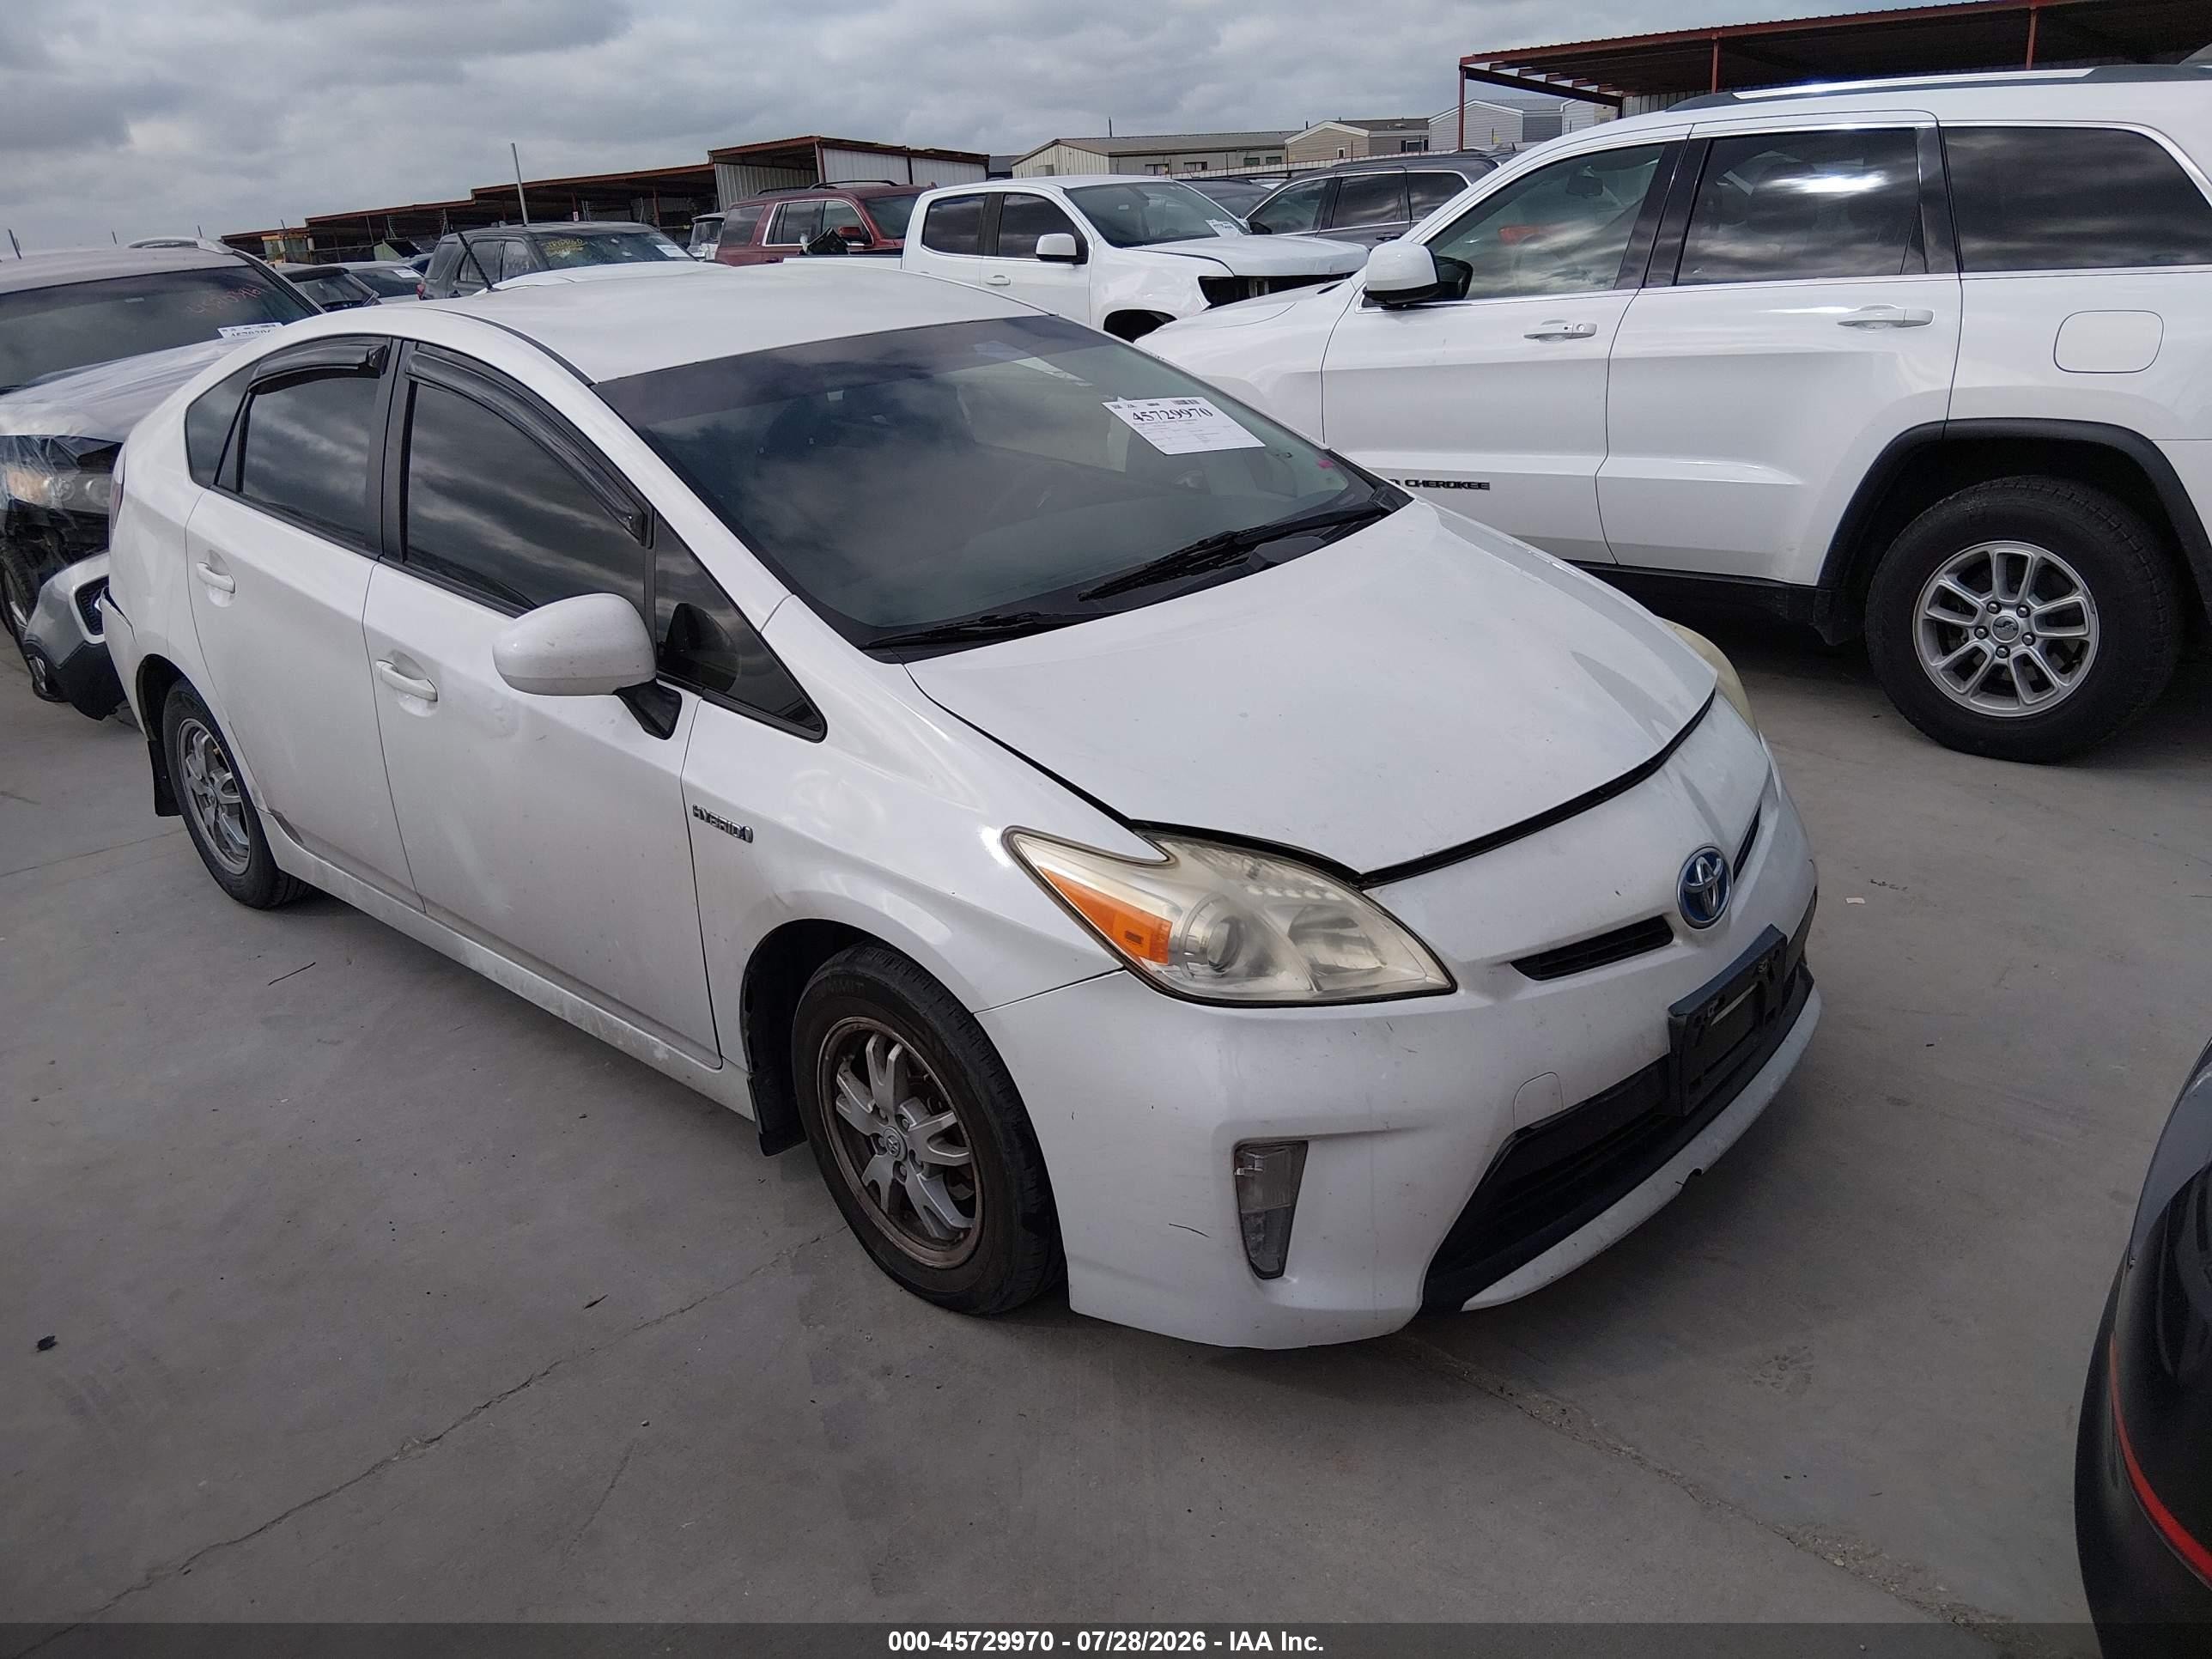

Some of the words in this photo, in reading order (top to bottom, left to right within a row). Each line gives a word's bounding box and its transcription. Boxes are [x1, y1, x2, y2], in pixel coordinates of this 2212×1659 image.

[1132, 407, 1214, 422] 45729970
[1404, 479, 1491, 491] CHEROKEE
[692, 805, 743, 839] HYBRID
